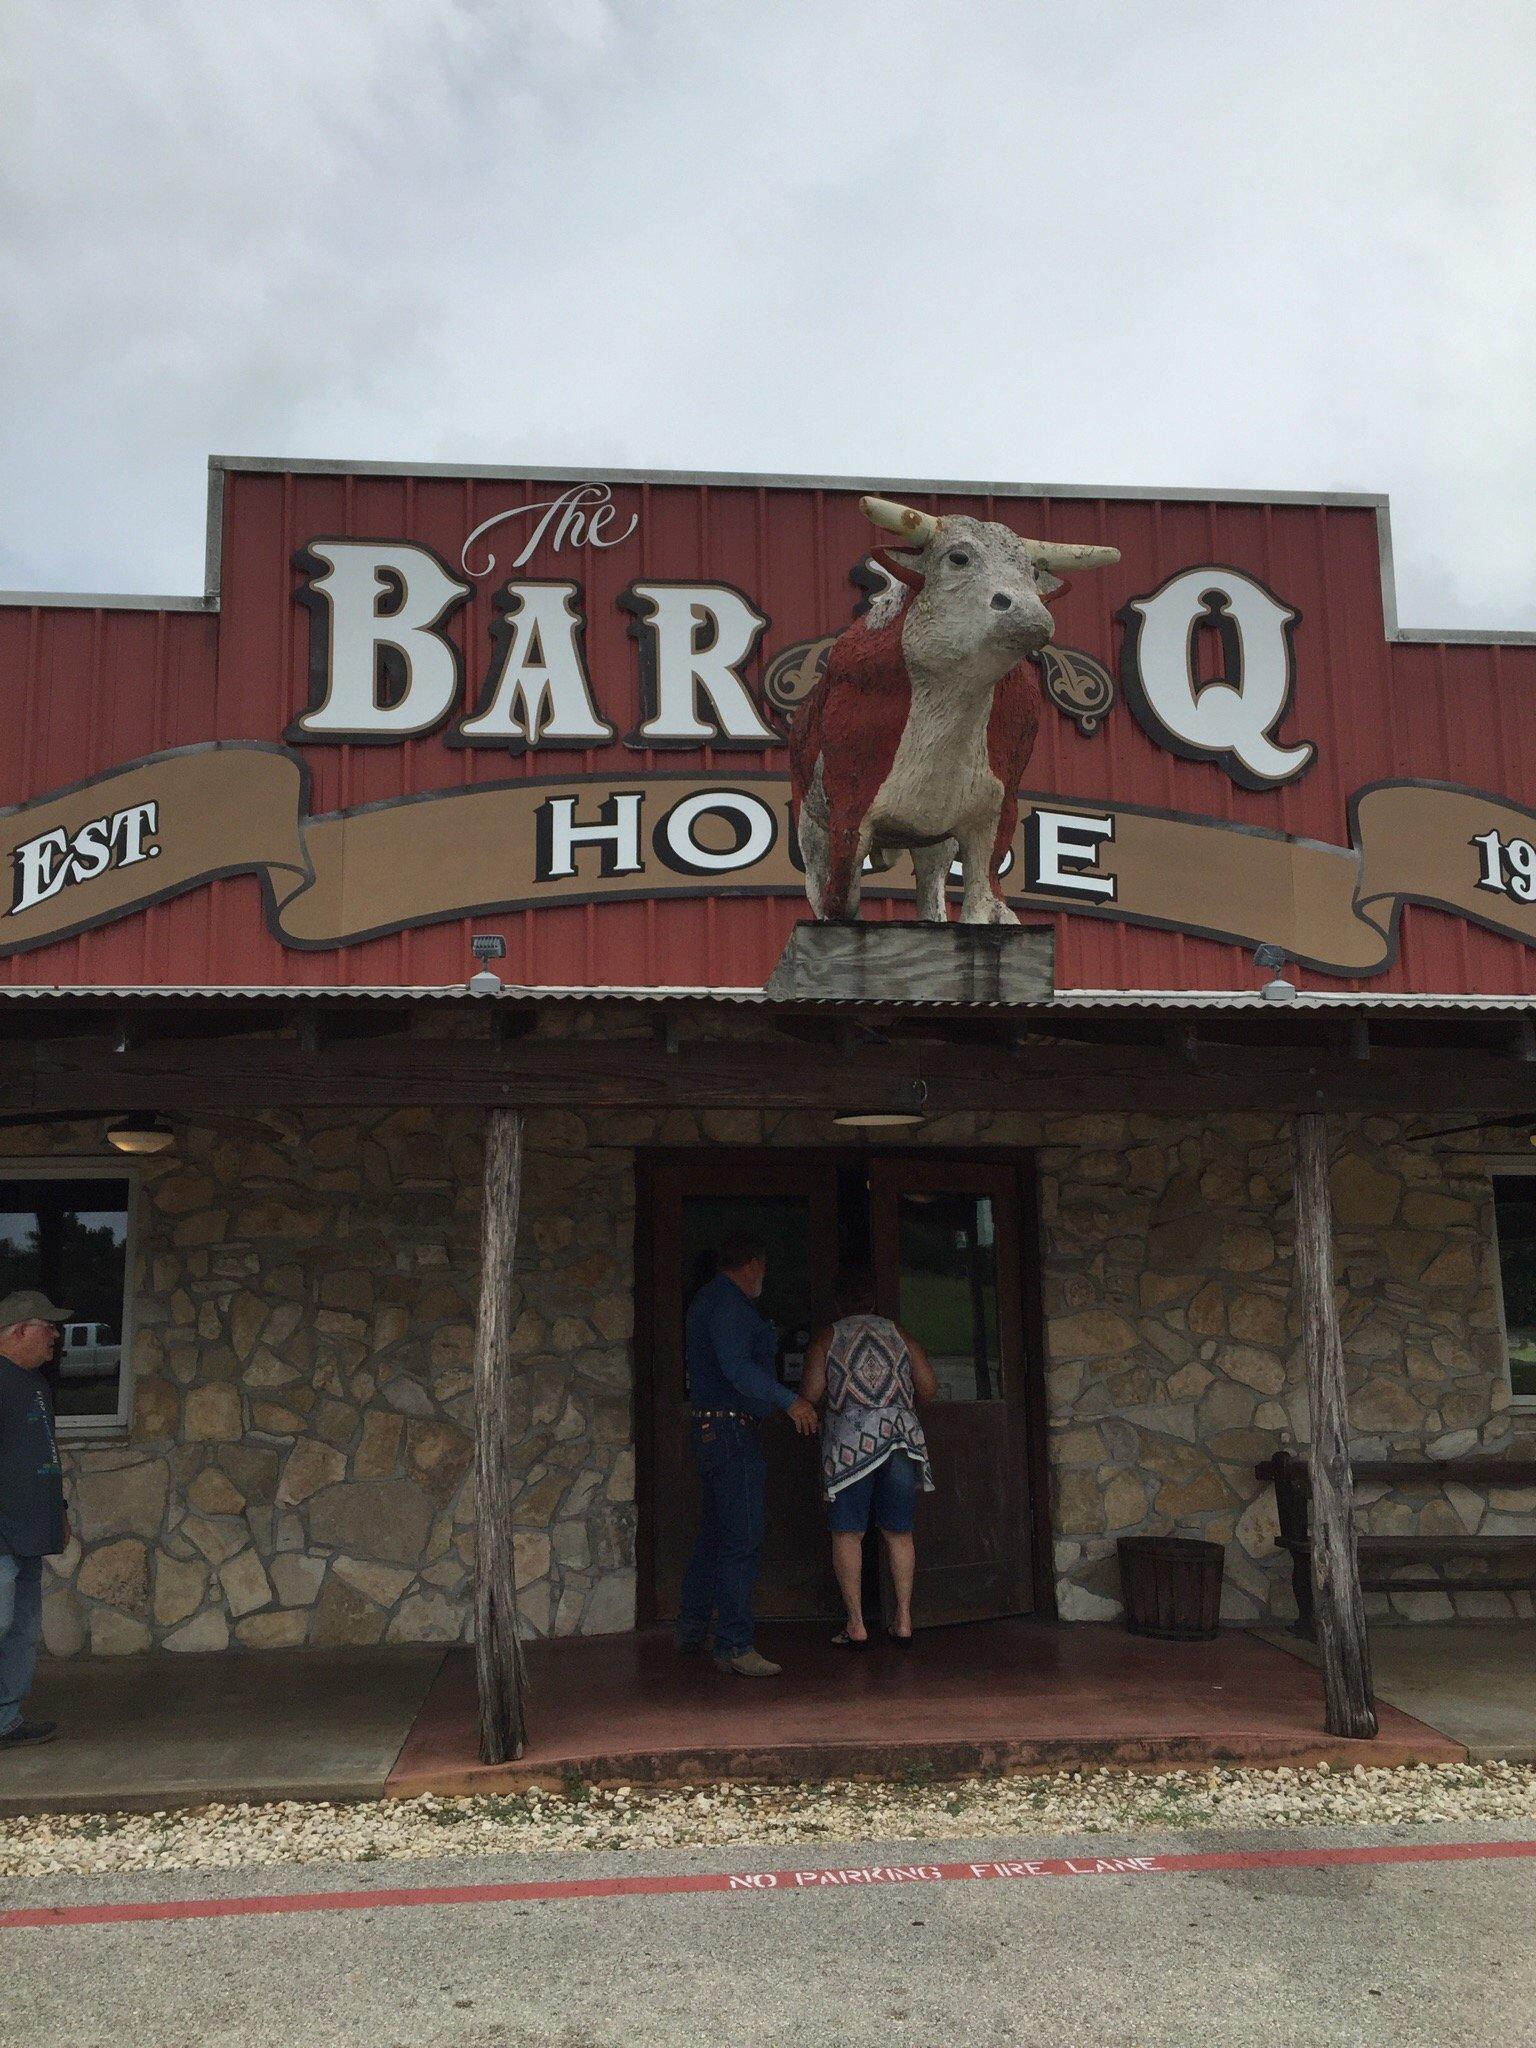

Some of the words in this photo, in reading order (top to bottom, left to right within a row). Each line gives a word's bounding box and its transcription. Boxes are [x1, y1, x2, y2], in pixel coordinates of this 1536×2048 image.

[462, 482, 639, 576] The
[297, 539, 784, 746] BAR
[1129, 564, 1317, 782] Q
[543, 790, 1115, 900] HOE
[728, 1873, 778, 1889] NO
[795, 1865, 941, 1887] PARKING
[968, 1861, 1052, 1879] FIRE
[1065, 1857, 1165, 1875] LANE
